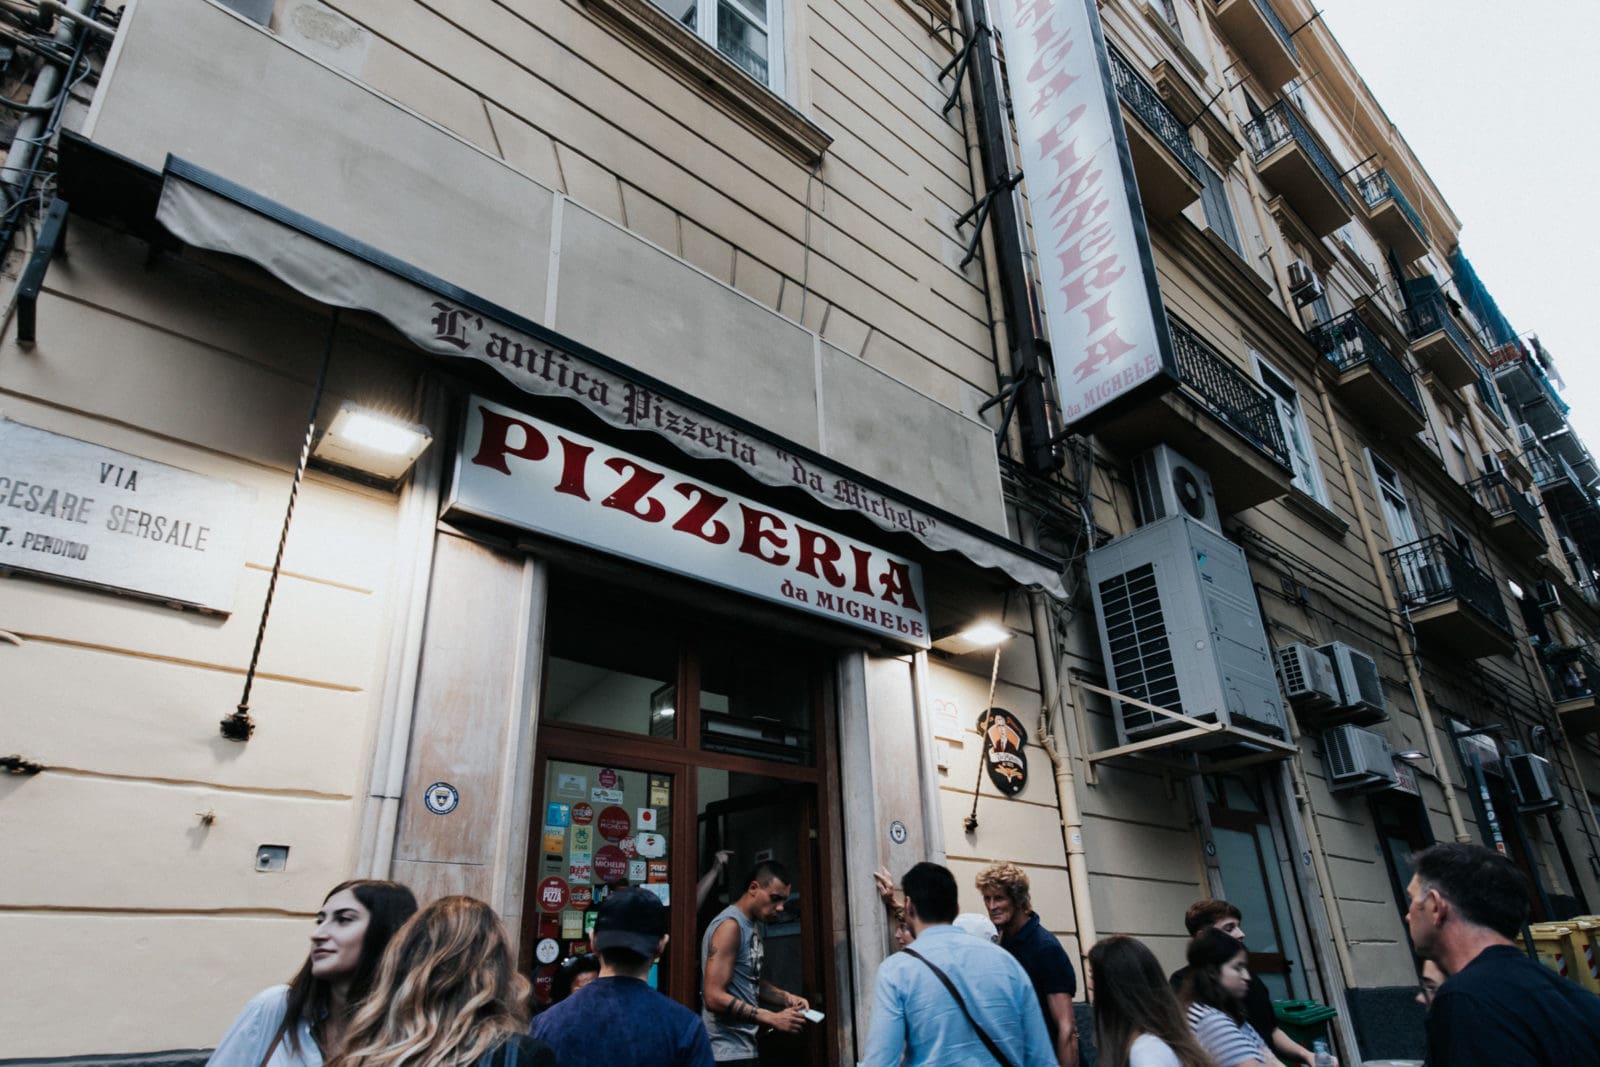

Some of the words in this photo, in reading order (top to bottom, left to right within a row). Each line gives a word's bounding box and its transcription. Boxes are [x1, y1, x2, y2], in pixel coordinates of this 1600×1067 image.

[1014, 0, 1081, 119] TICA
[1036, 103, 1139, 386] PIZZERIA
[430, 301, 609, 406] L'antica
[622, 382, 758, 466] Pizzeria
[1066, 403, 1081, 418] da
[1083, 354, 1156, 409] MICHELE
[0, 476, 95, 524] CESARE
[106, 504, 210, 552] SERSALE
[100, 462, 140, 492] VIA
[471, 406, 923, 613] PIZZERIA
[780, 578, 809, 603] da
[816, 590, 924, 638] MICHELE
[595, 860, 625, 870] MICHELIN
